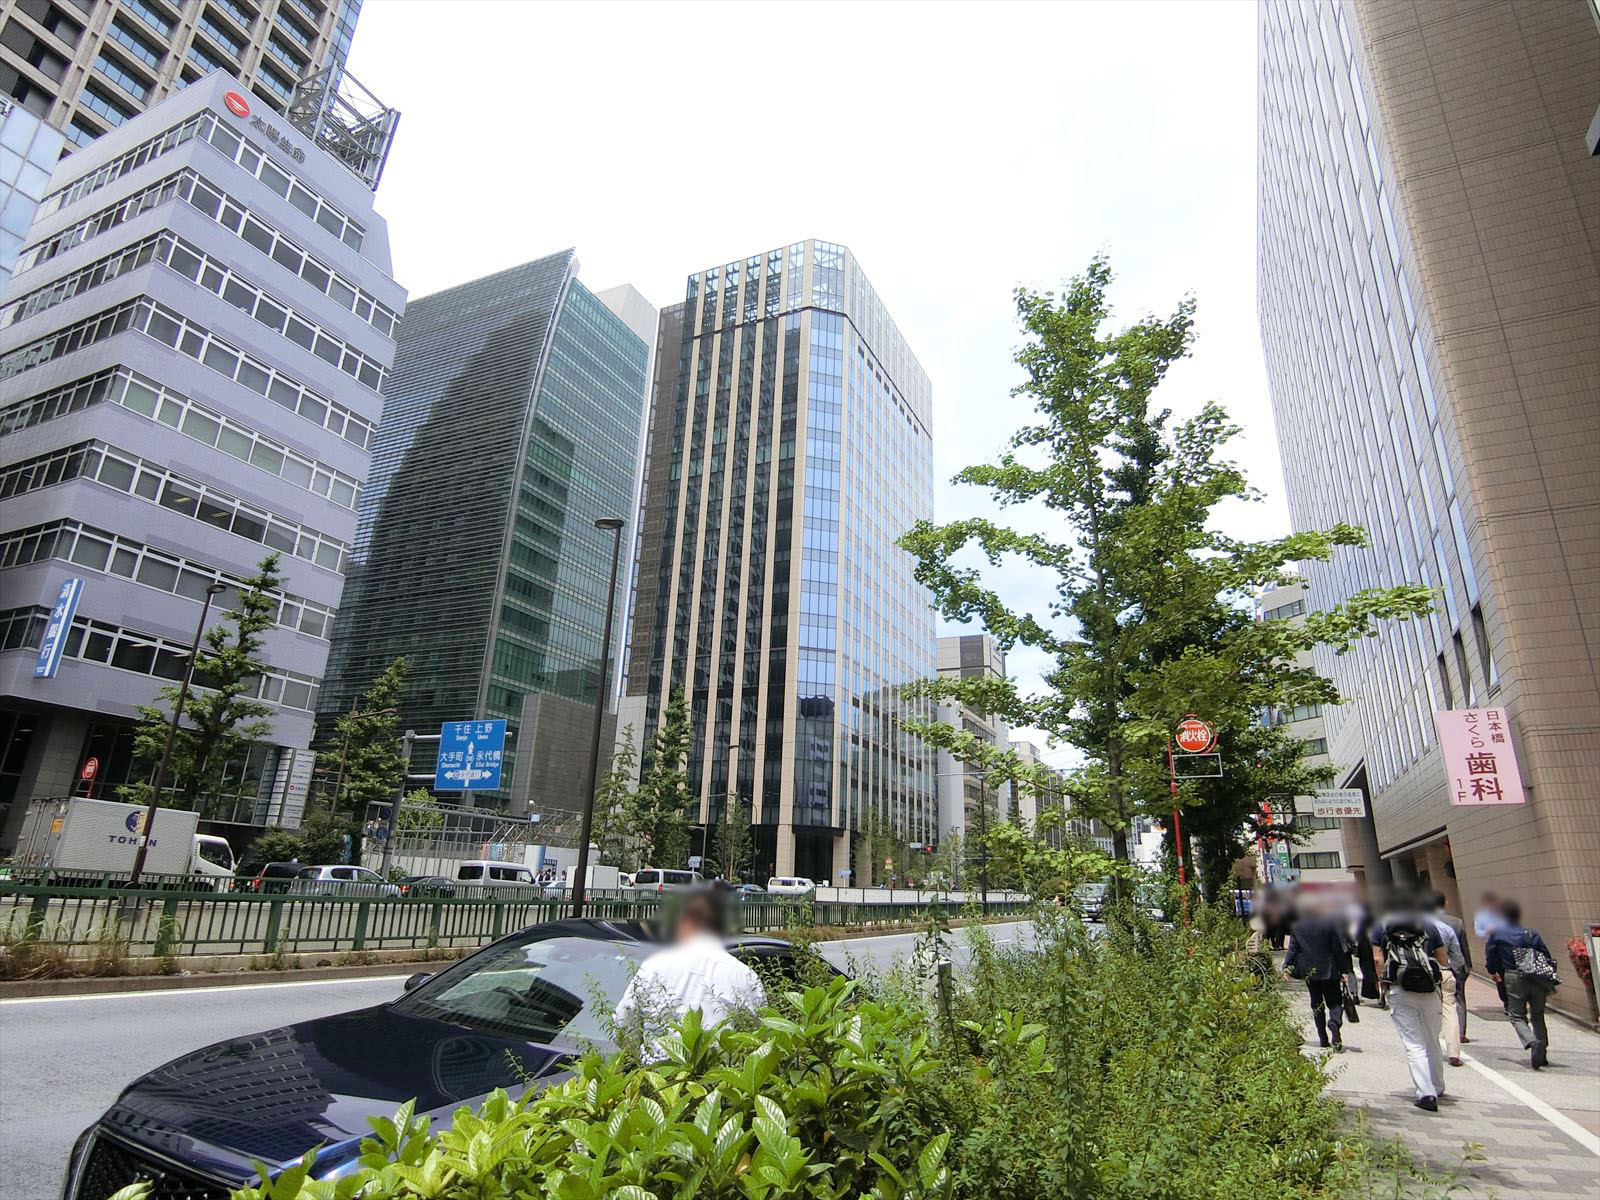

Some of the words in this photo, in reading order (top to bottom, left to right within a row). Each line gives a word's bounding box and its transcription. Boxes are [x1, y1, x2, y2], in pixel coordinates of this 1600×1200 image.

[249, 114, 306, 164] 太陽生命
[41, 583, 71, 659] 清水銀行
[475, 723, 493, 734] 上野
[1180, 729, 1208, 742] 消火栓
[1463, 711, 1485, 749] さくら
[1486, 710, 1505, 744] 日本橋
[440, 751, 464, 762] 大手町
[475, 750, 501, 761] 永代橋
[1464, 751, 1504, 802] 歯科
[1317, 807, 1362, 815] 歩行者優先
[108, 835, 158, 847] TOHN
